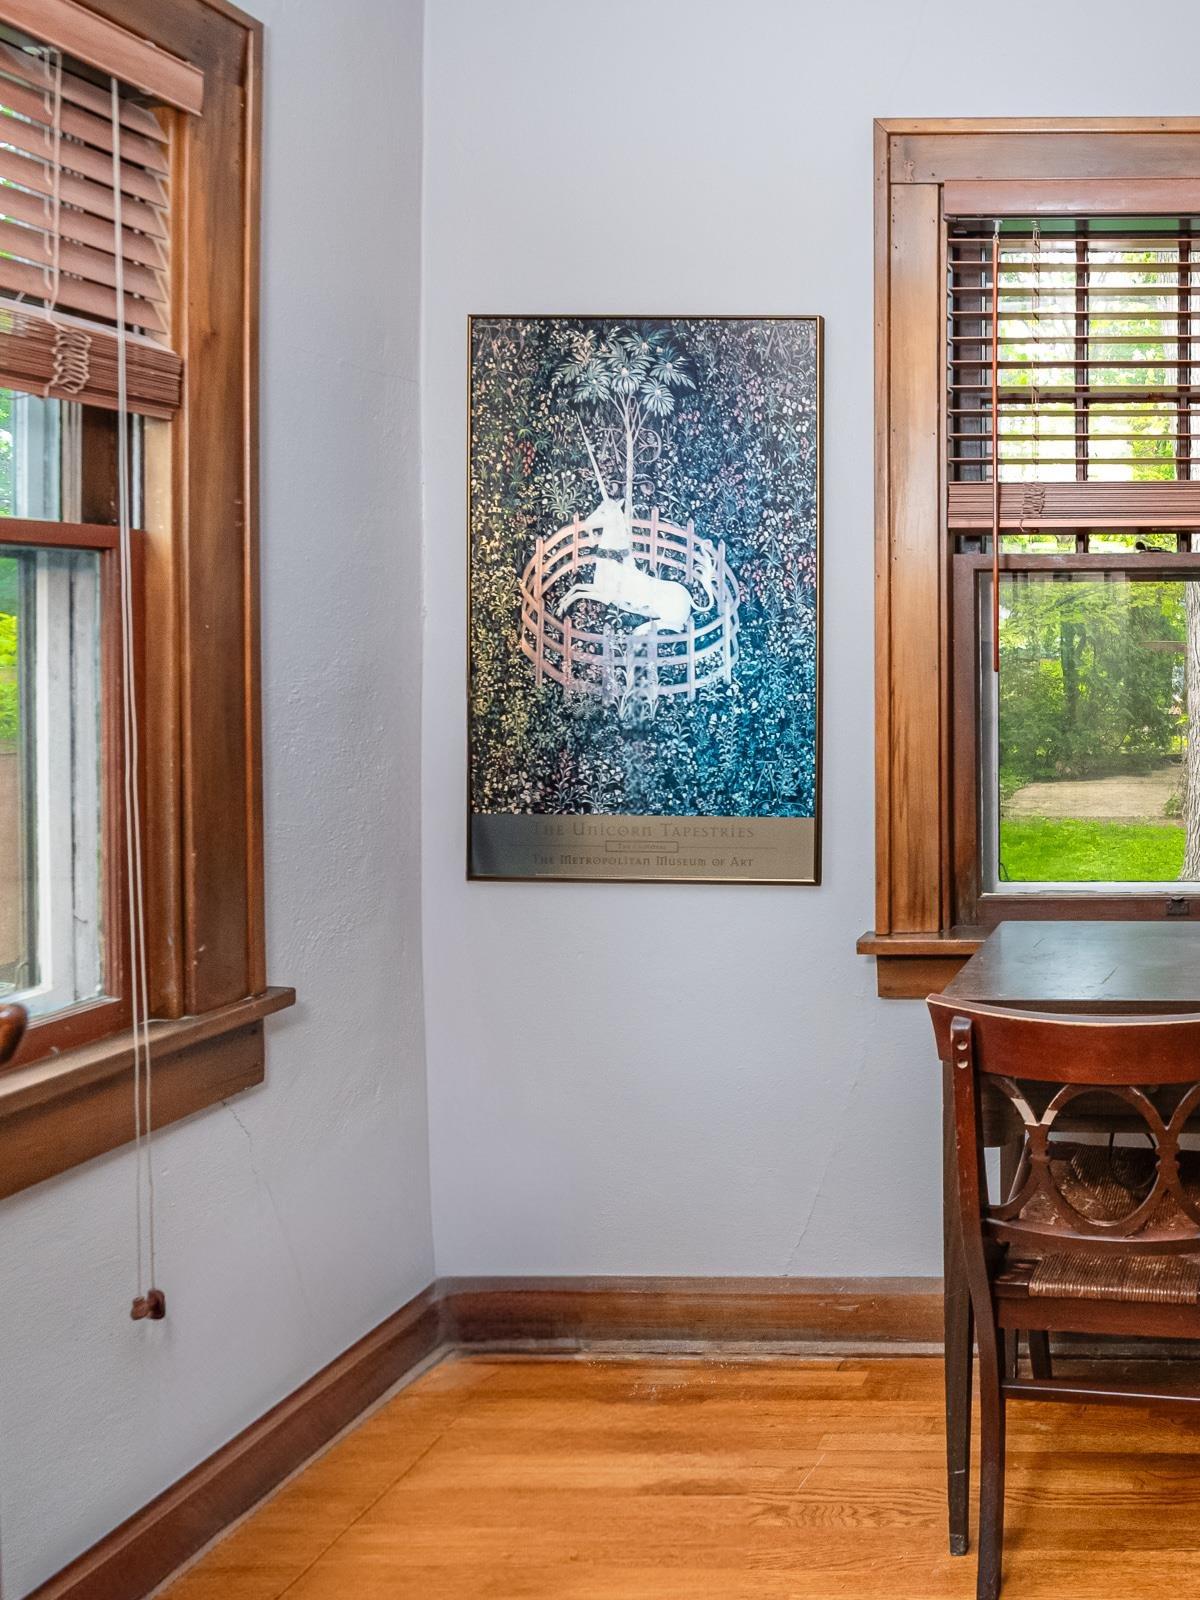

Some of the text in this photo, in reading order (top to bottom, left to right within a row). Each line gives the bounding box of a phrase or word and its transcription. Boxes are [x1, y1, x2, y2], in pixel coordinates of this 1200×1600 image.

[532, 821, 755, 840] THE UNICORN TAPESTRIES
[532, 854, 754, 869] THE METROPOLITAN MUSEUM OF ART
